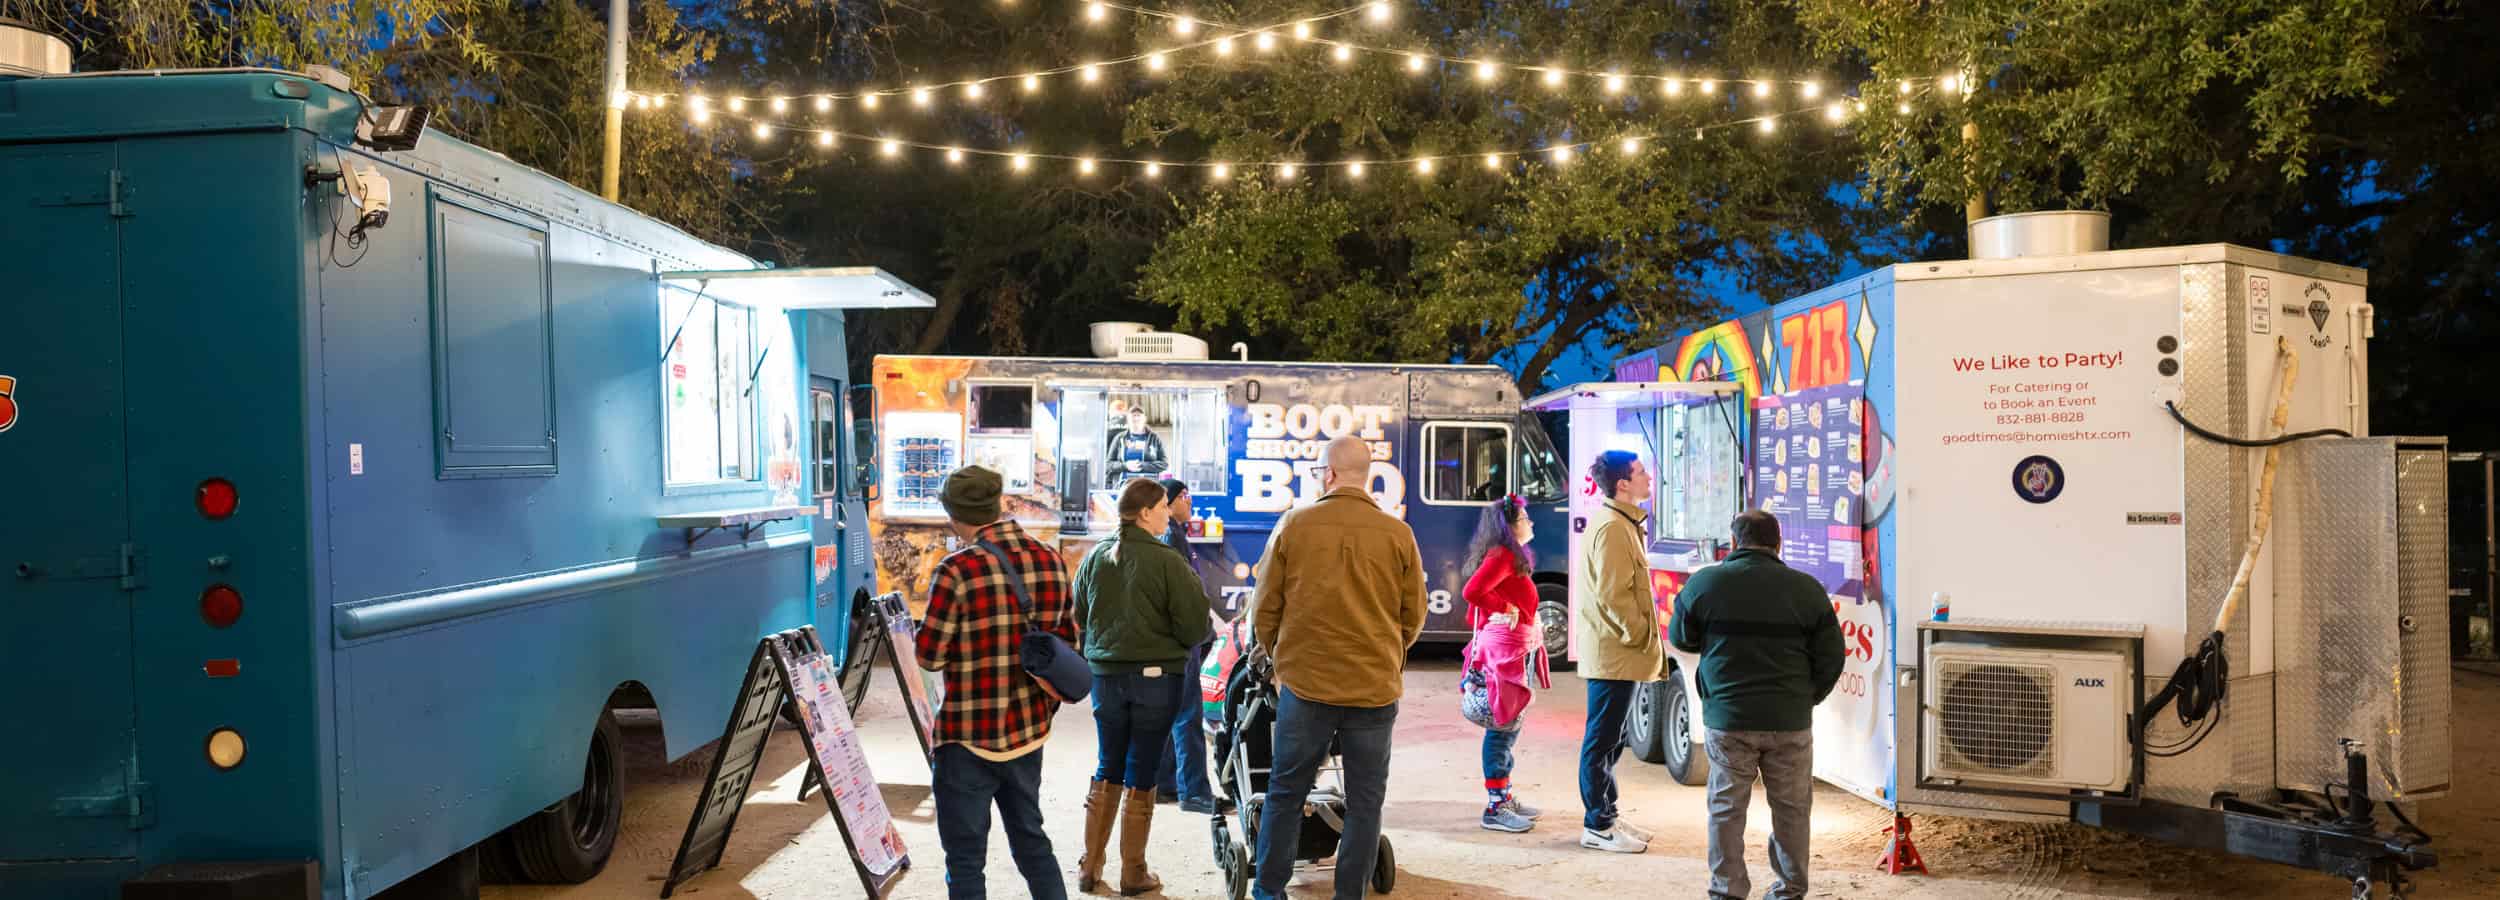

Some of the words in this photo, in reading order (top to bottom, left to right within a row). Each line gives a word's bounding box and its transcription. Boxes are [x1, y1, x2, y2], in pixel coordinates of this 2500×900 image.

[1782, 299, 1851, 393] 713
[1953, 356, 1985, 372] We
[1991, 354, 2031, 371] Like
[2038, 355, 2059, 369] to
[2065, 350, 2123, 369] Party!
[1989, 384, 2010, 394] For
[2014, 382, 2072, 393] Catering
[2076, 381, 2089, 391] or
[1983, 399, 1997, 410] to
[2001, 397, 2034, 410] Book
[2038, 398, 2055, 408] an
[2058, 395, 2097, 407] Event
[1247, 403, 1393, 440] BOOT
[1996, 411, 2085, 425] 832-881-8828
[1942, 430, 2131, 445] goodtimes@homieshtx.com
[1837, 671, 1866, 697] OOD
[2074, 678, 2105, 688] AUX
